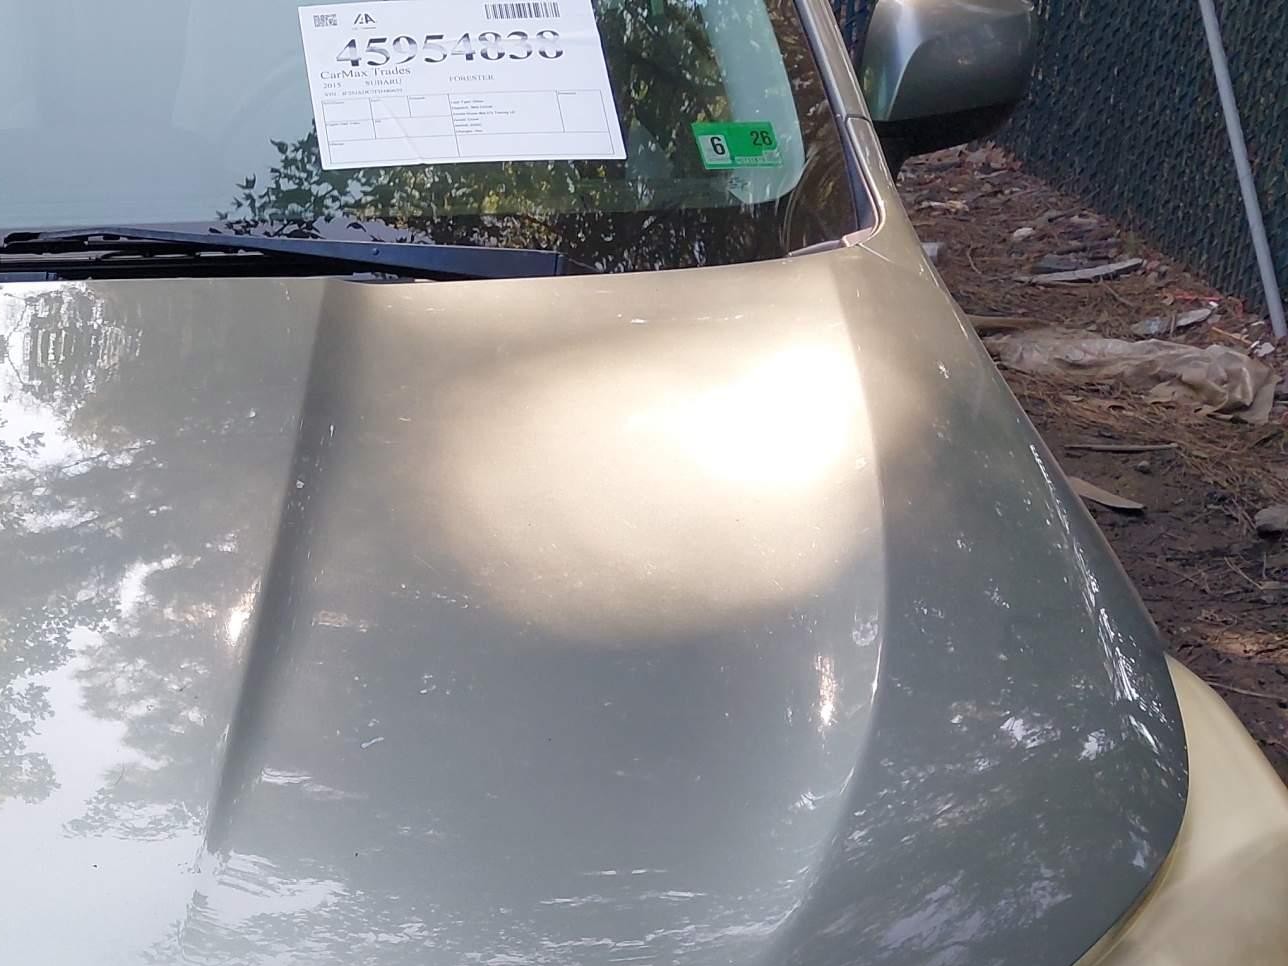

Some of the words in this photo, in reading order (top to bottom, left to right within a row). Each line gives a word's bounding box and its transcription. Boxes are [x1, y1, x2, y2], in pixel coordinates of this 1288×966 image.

[320, 70, 369, 81] CarMax
[372, 66, 411, 77] Trades
[365, 78, 402, 86] SUBARU
[710, 136, 726, 155] 6
[750, 130, 772, 146] 26
